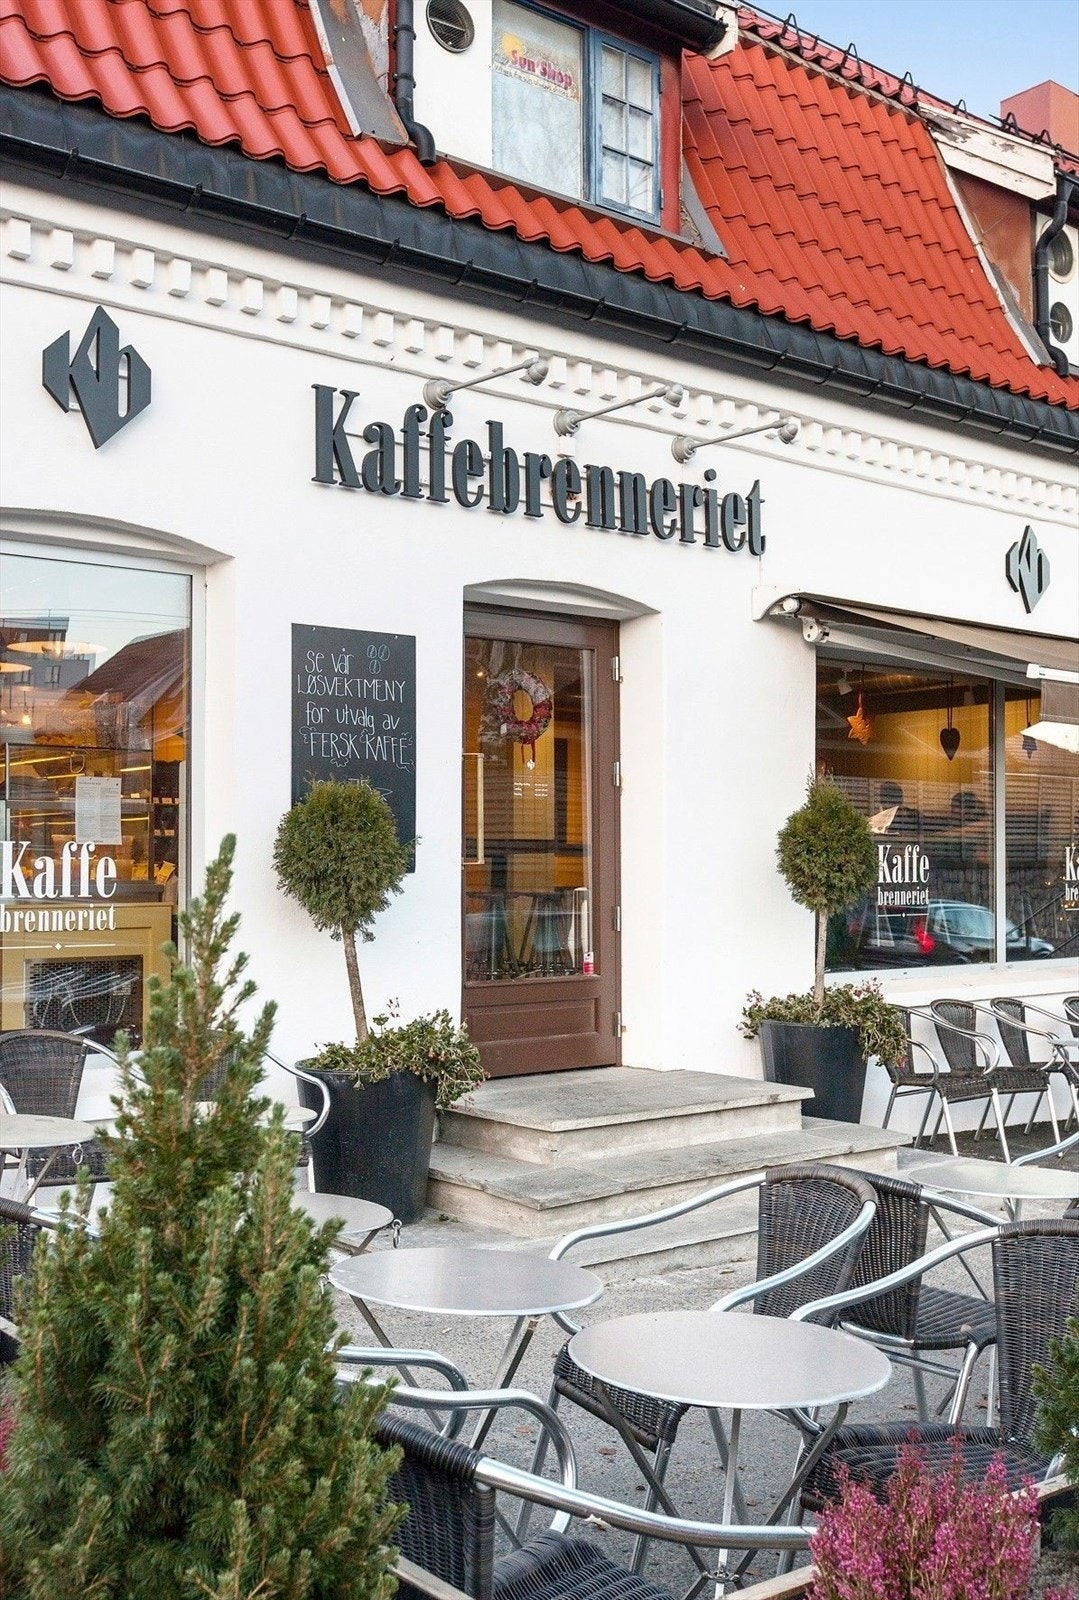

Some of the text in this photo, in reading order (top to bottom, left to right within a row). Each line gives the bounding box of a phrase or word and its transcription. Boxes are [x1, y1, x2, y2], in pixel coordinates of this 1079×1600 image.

[511, 49, 536, 73] Sun
[311, 384, 766, 557] Kaffebrenneriet
[331, 647, 355, 675] vår
[297, 674, 406, 703] LØSVEKTMENY
[305, 701, 401, 736] for utvalg av
[310, 732, 411, 765] FERSK KAFFE
[0, 840, 117, 899] Kaffe
[877, 844, 930, 884] Kaffe
[877, 886, 930, 906] brenneriet
[0, 903, 117, 933] brenneriet
